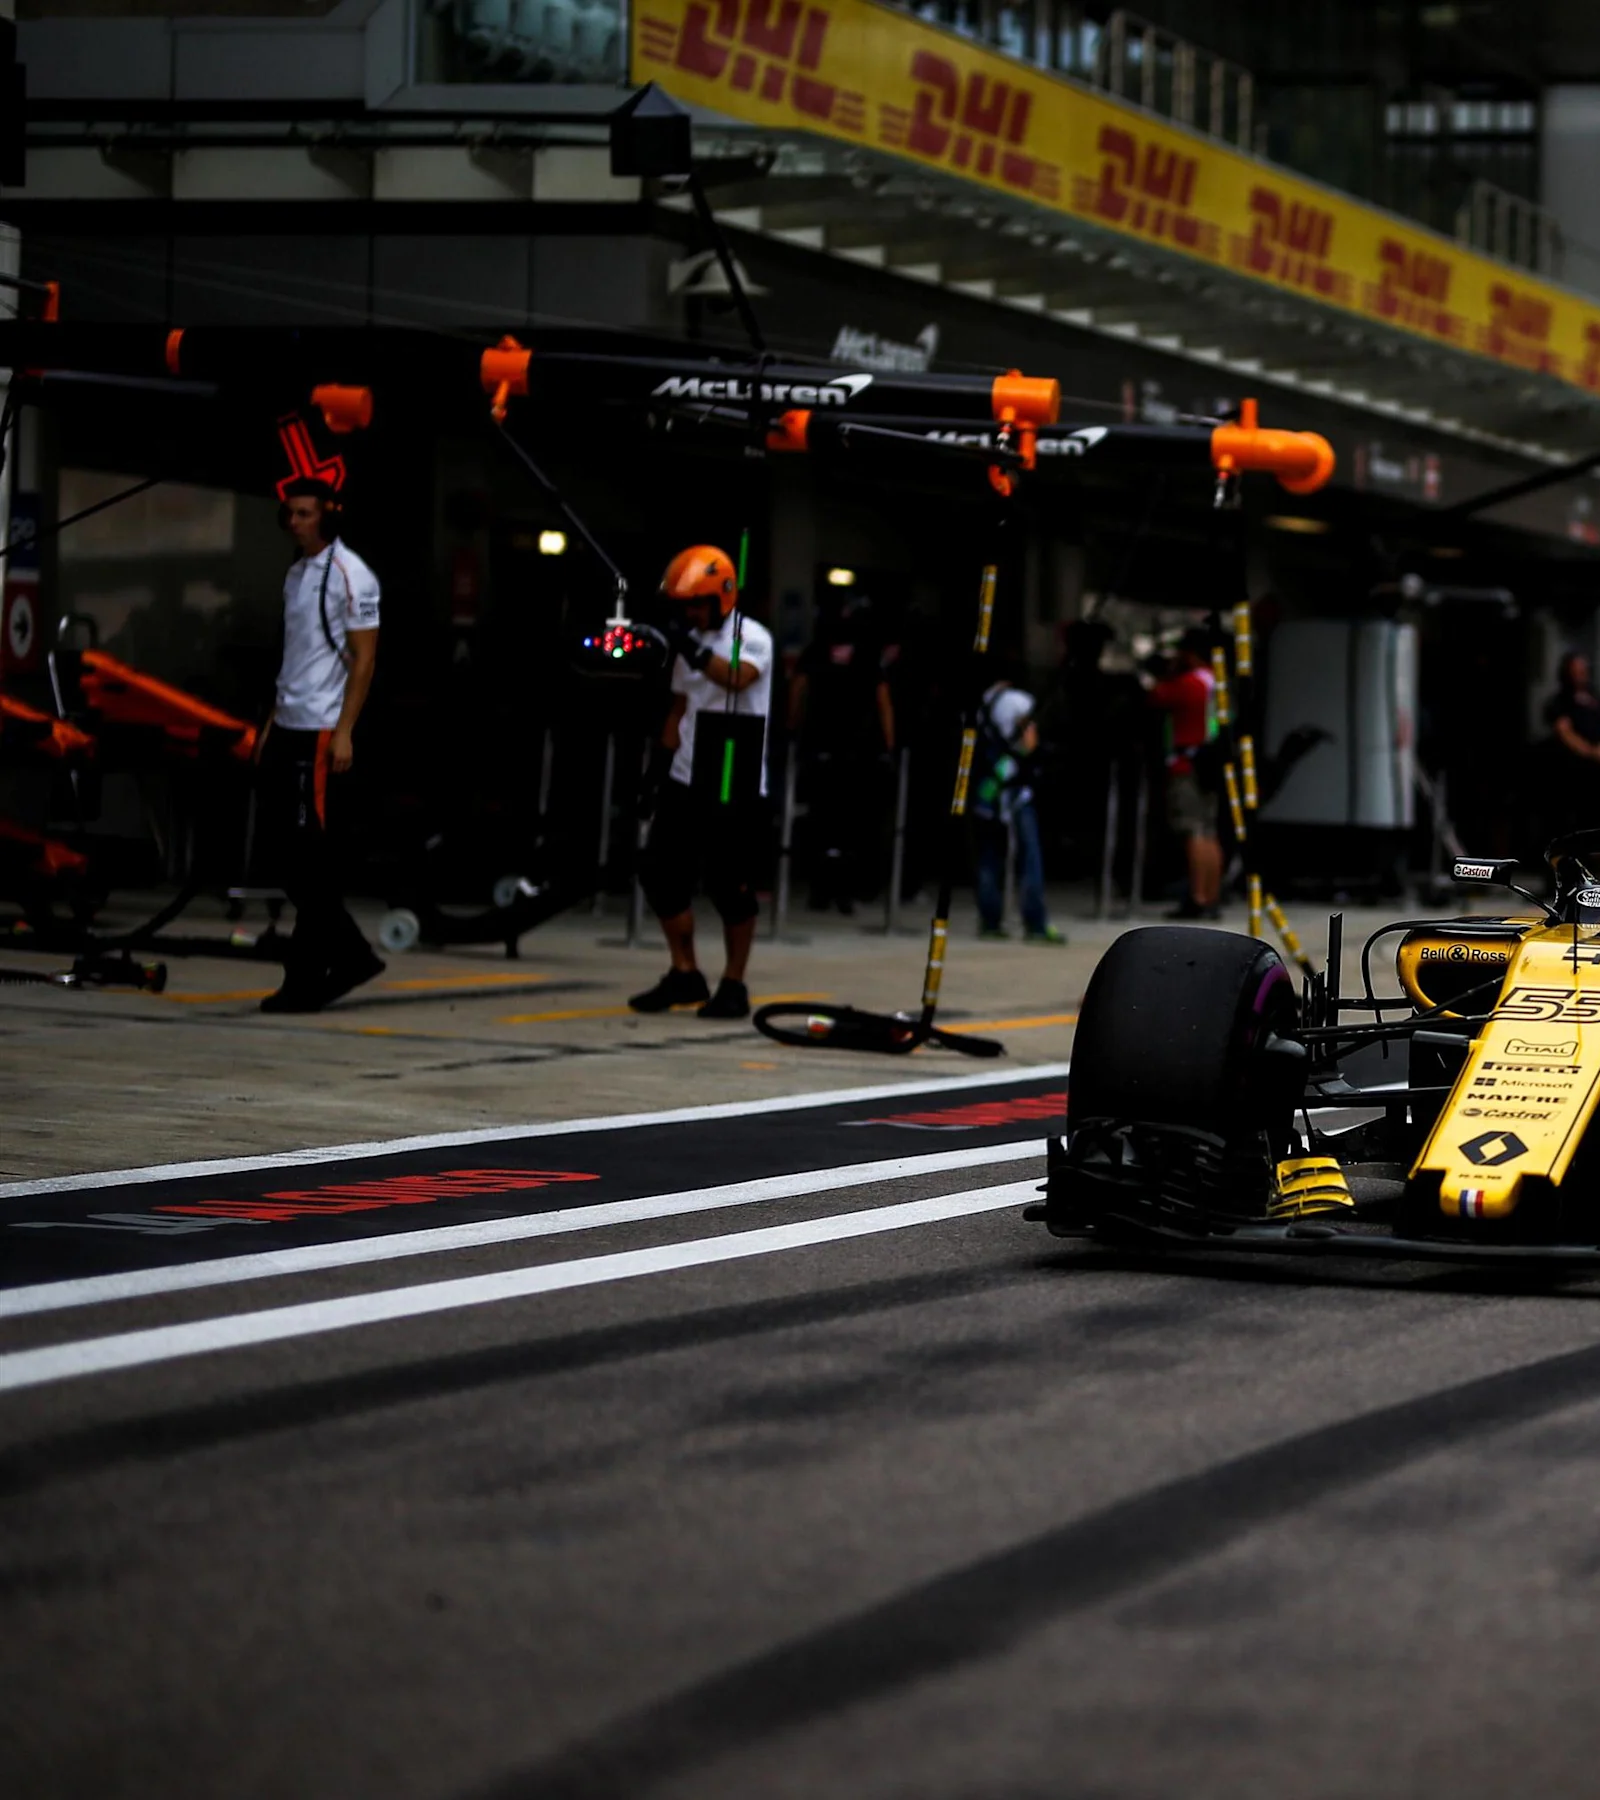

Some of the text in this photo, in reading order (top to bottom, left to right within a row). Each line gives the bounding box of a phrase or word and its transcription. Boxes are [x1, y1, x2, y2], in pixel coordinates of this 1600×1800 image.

[909, 50, 1036, 187] DHL
[1098, 124, 1199, 246] DHL
[1248, 188, 1334, 294] DHL
[1461, 866, 1491, 878] Castrol
[1421, 947, 1446, 960] Bell
[1471, 949, 1506, 962] Ross
[1500, 1079, 1574, 1089] Microsoft
[1466, 1093, 1568, 1103] MAPFRE
[1483, 1109, 1551, 1120] Castrol
